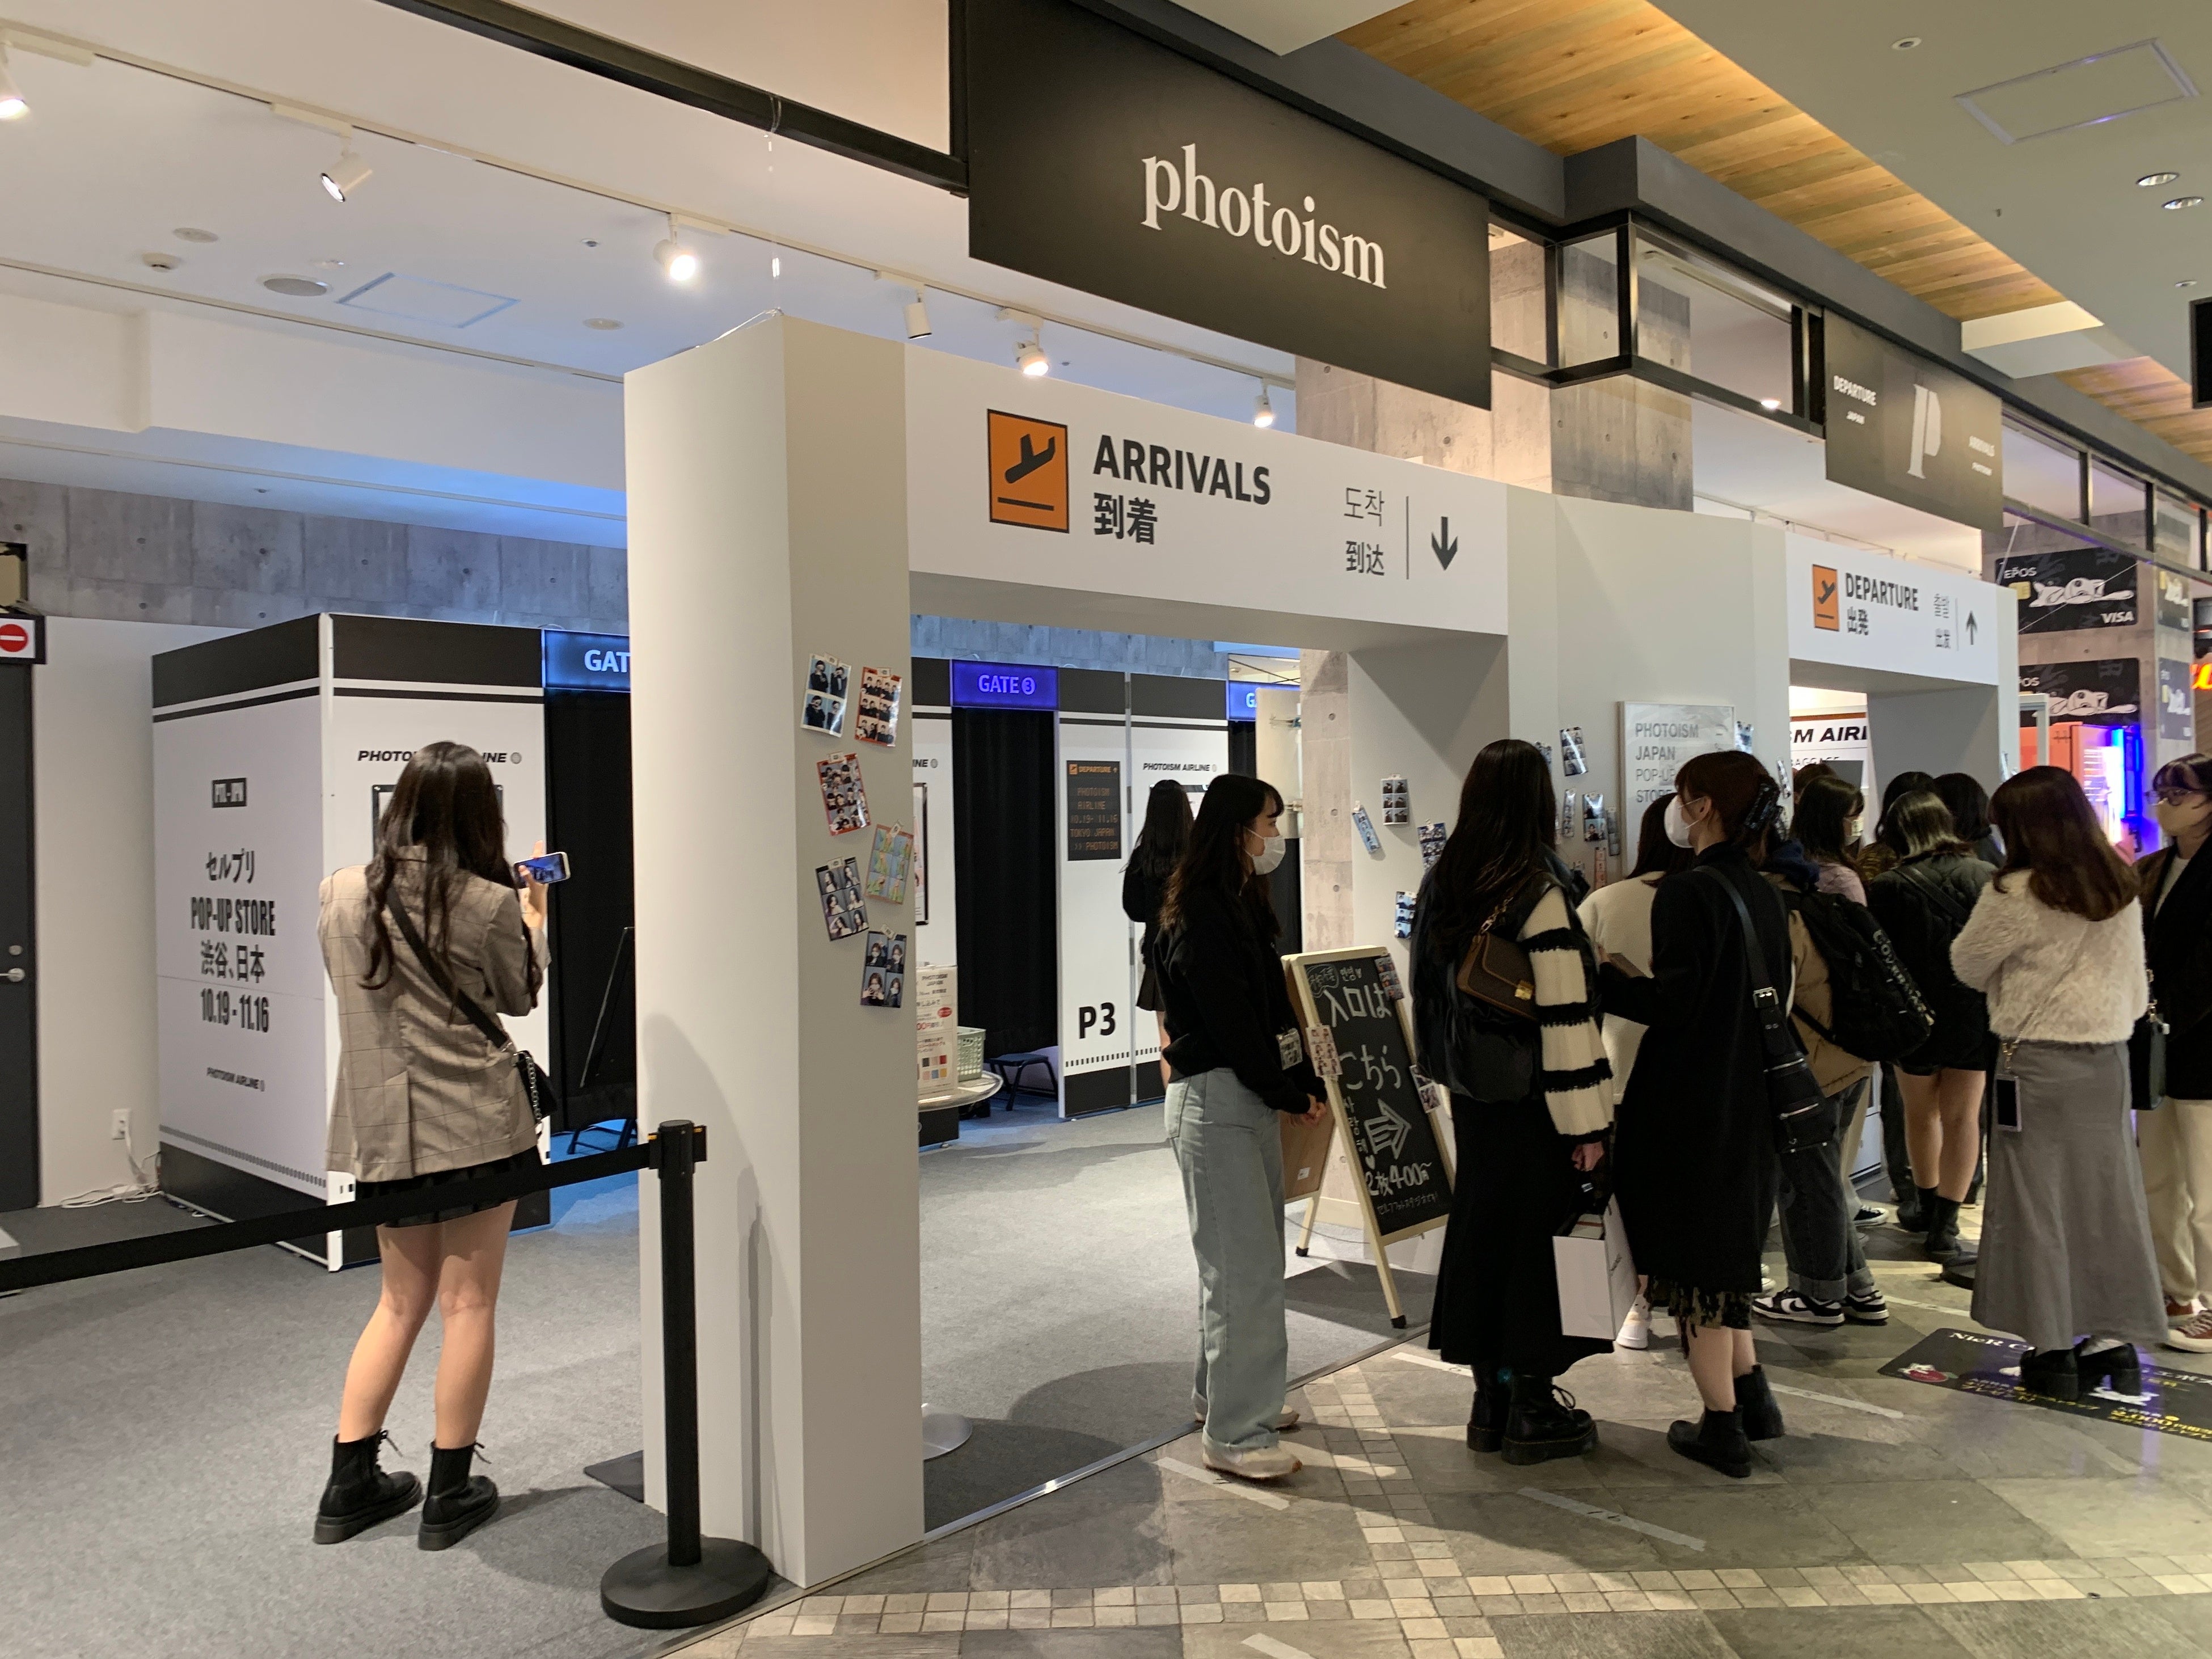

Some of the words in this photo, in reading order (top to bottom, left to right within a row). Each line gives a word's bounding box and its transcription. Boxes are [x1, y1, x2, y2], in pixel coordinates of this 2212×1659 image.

[1141, 143, 1387, 289] photoism
[1093, 434, 1271, 506] ARRIVALS
[1094, 492, 1158, 545] 到着
[1344, 487, 1384, 527] 도착
[1345, 541, 1385, 576] 到达
[2004, 567, 2037, 579] EPOS
[1846, 572, 1919, 611] DEPARTURE
[2100, 610, 2134, 624] VISA
[978, 674, 1020, 694] GATE
[2019, 676, 2040, 687] OS
[1246, 693, 1257, 708] G
[1635, 723, 1699, 738] PHOTOISM
[1789, 728, 1814, 743] M
[1142, 763, 1181, 772] PHOTOISM
[1182, 763, 1210, 772] AIRLINE
[1635, 746, 1675, 761] JAPAN
[1636, 789, 1673, 803] STO
[191, 897, 233, 932] POP-UP
[235, 899, 276, 936] STORE
[201, 939, 265, 983] 渋谷、日本
[201, 988, 230, 1025] 10.19
[239, 994, 269, 1033] 11.16
[1079, 1002, 1116, 1039] P3
[1323, 983, 1392, 1028] 入口は
[1340, 1044, 1402, 1091] こちら
